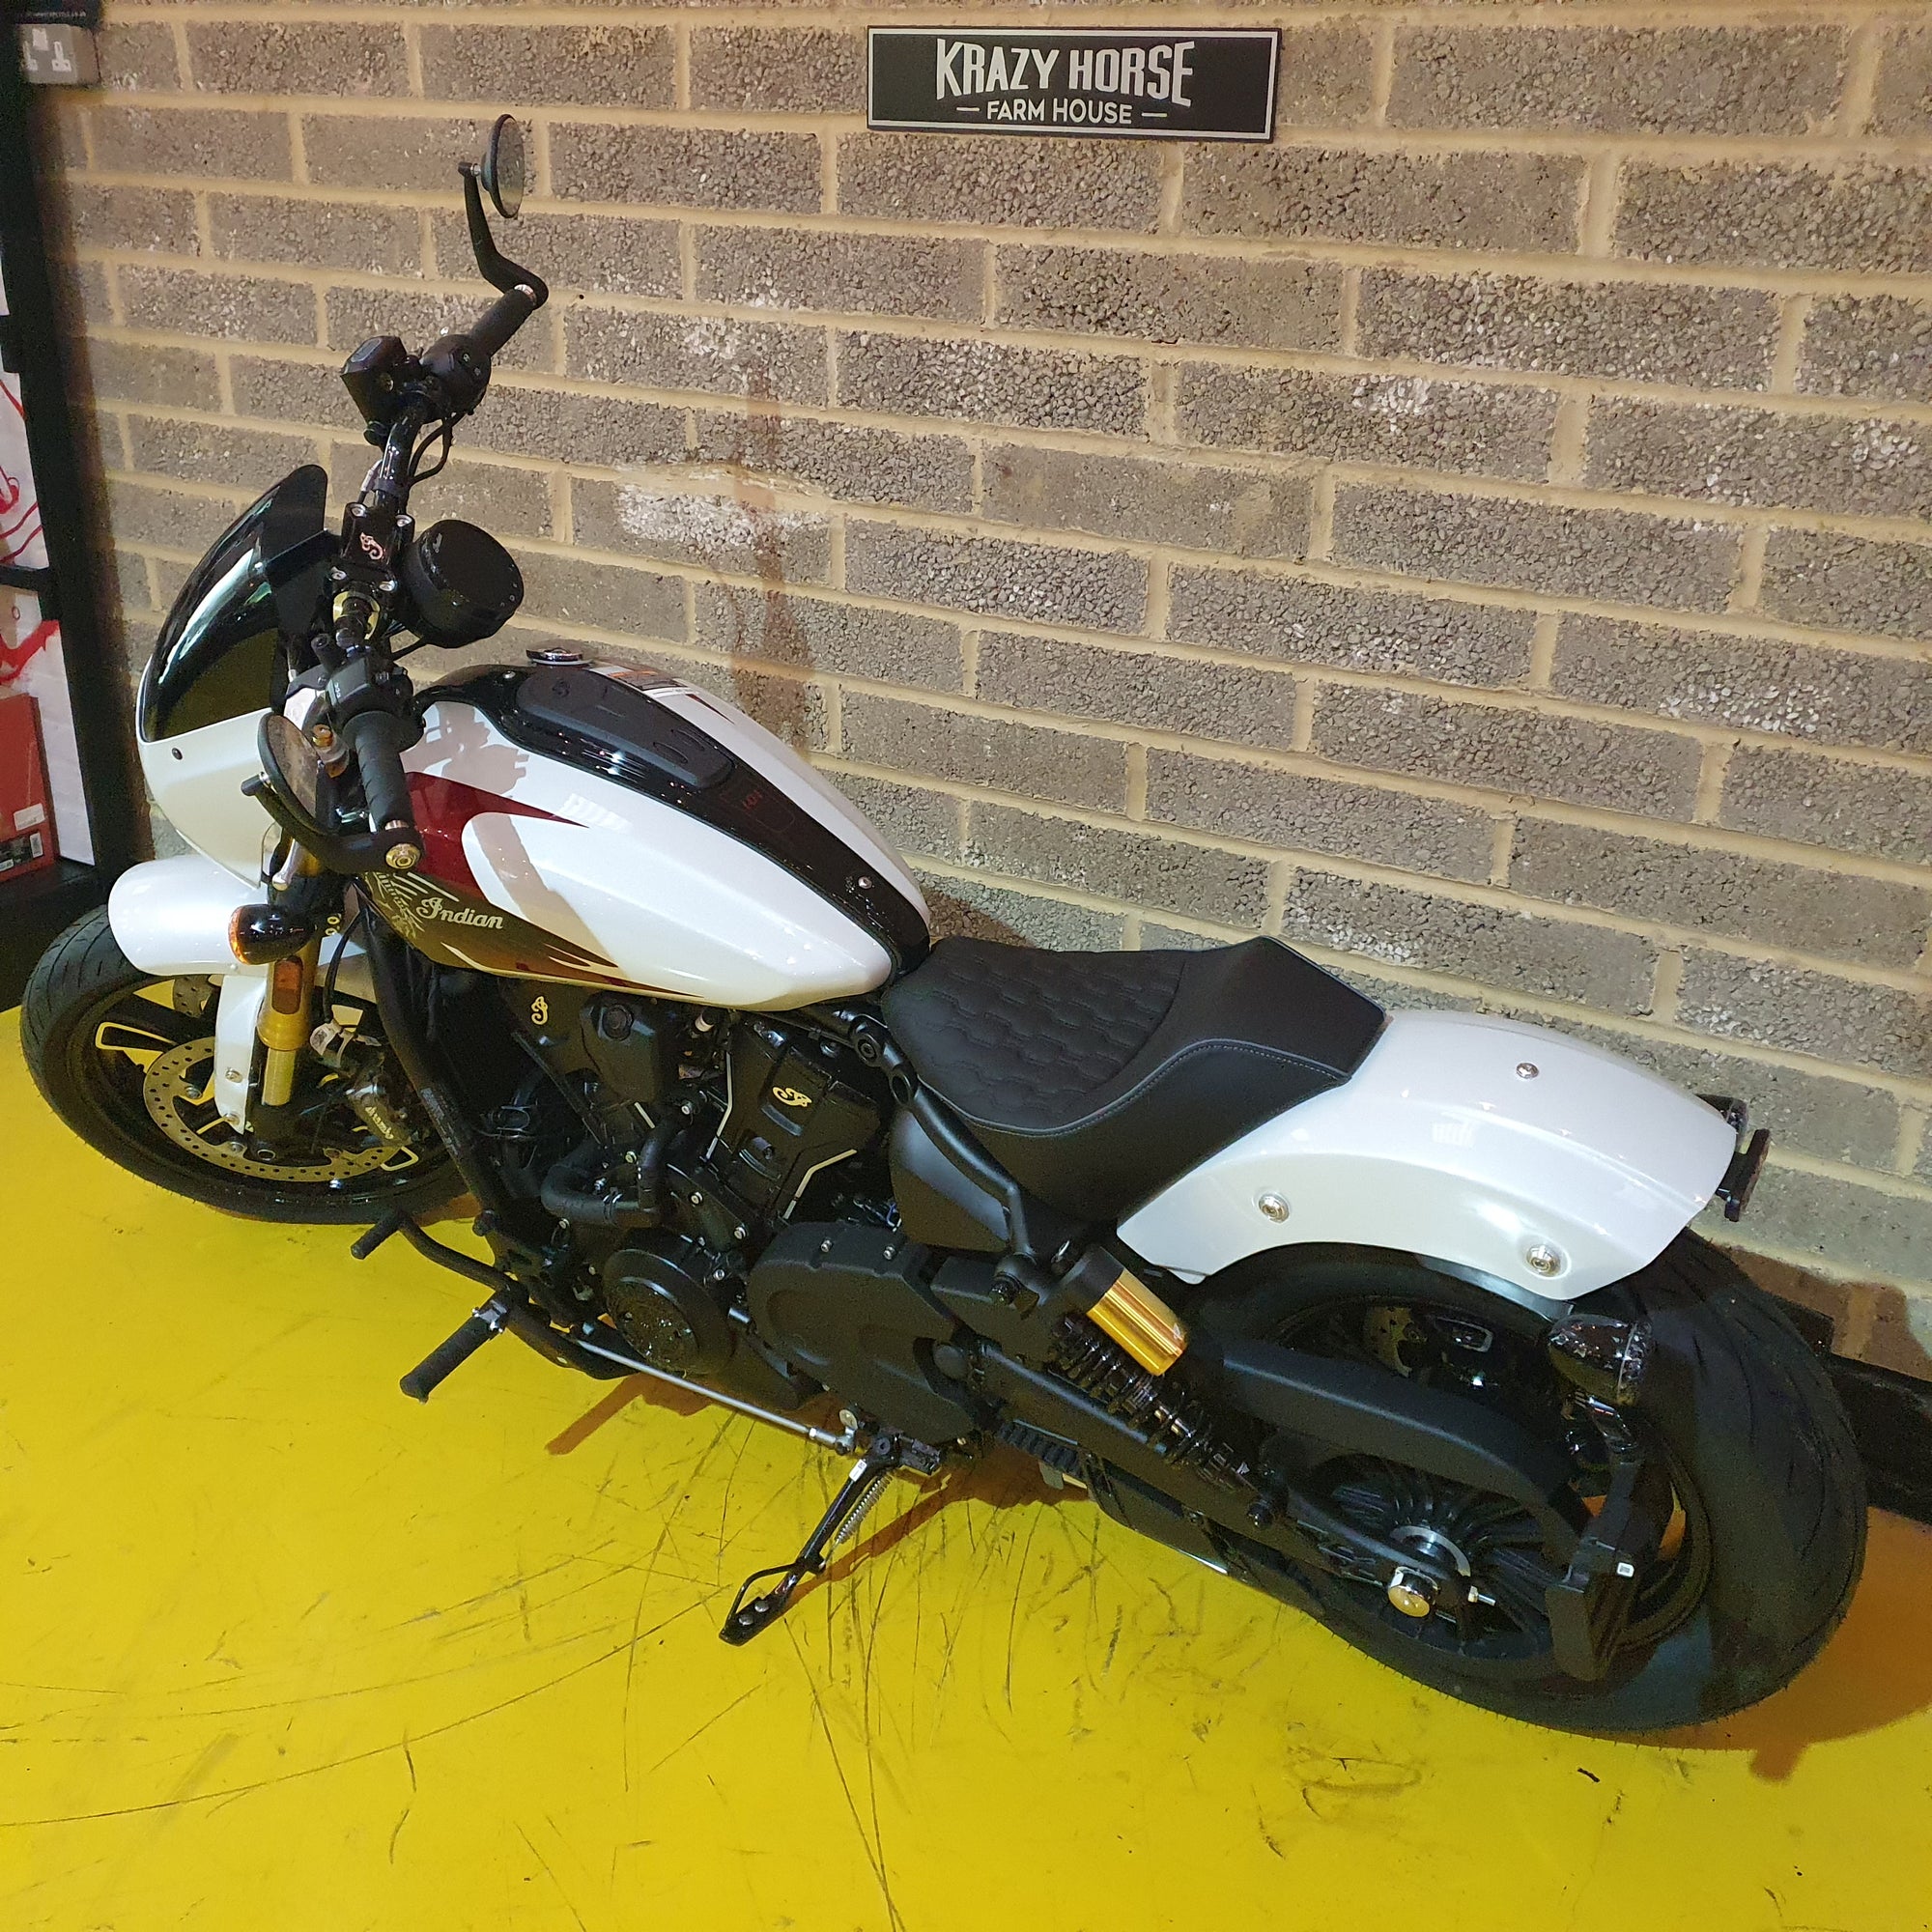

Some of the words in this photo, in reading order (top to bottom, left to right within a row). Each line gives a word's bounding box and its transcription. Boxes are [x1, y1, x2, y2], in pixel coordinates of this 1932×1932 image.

[936, 38, 1060, 100] KRAZY
[1068, 41, 1195, 108] HORSE
[986, 98, 1045, 122] FARM
[1053, 98, 1133, 125] HOUSE
[415, 896, 503, 929] Indian
